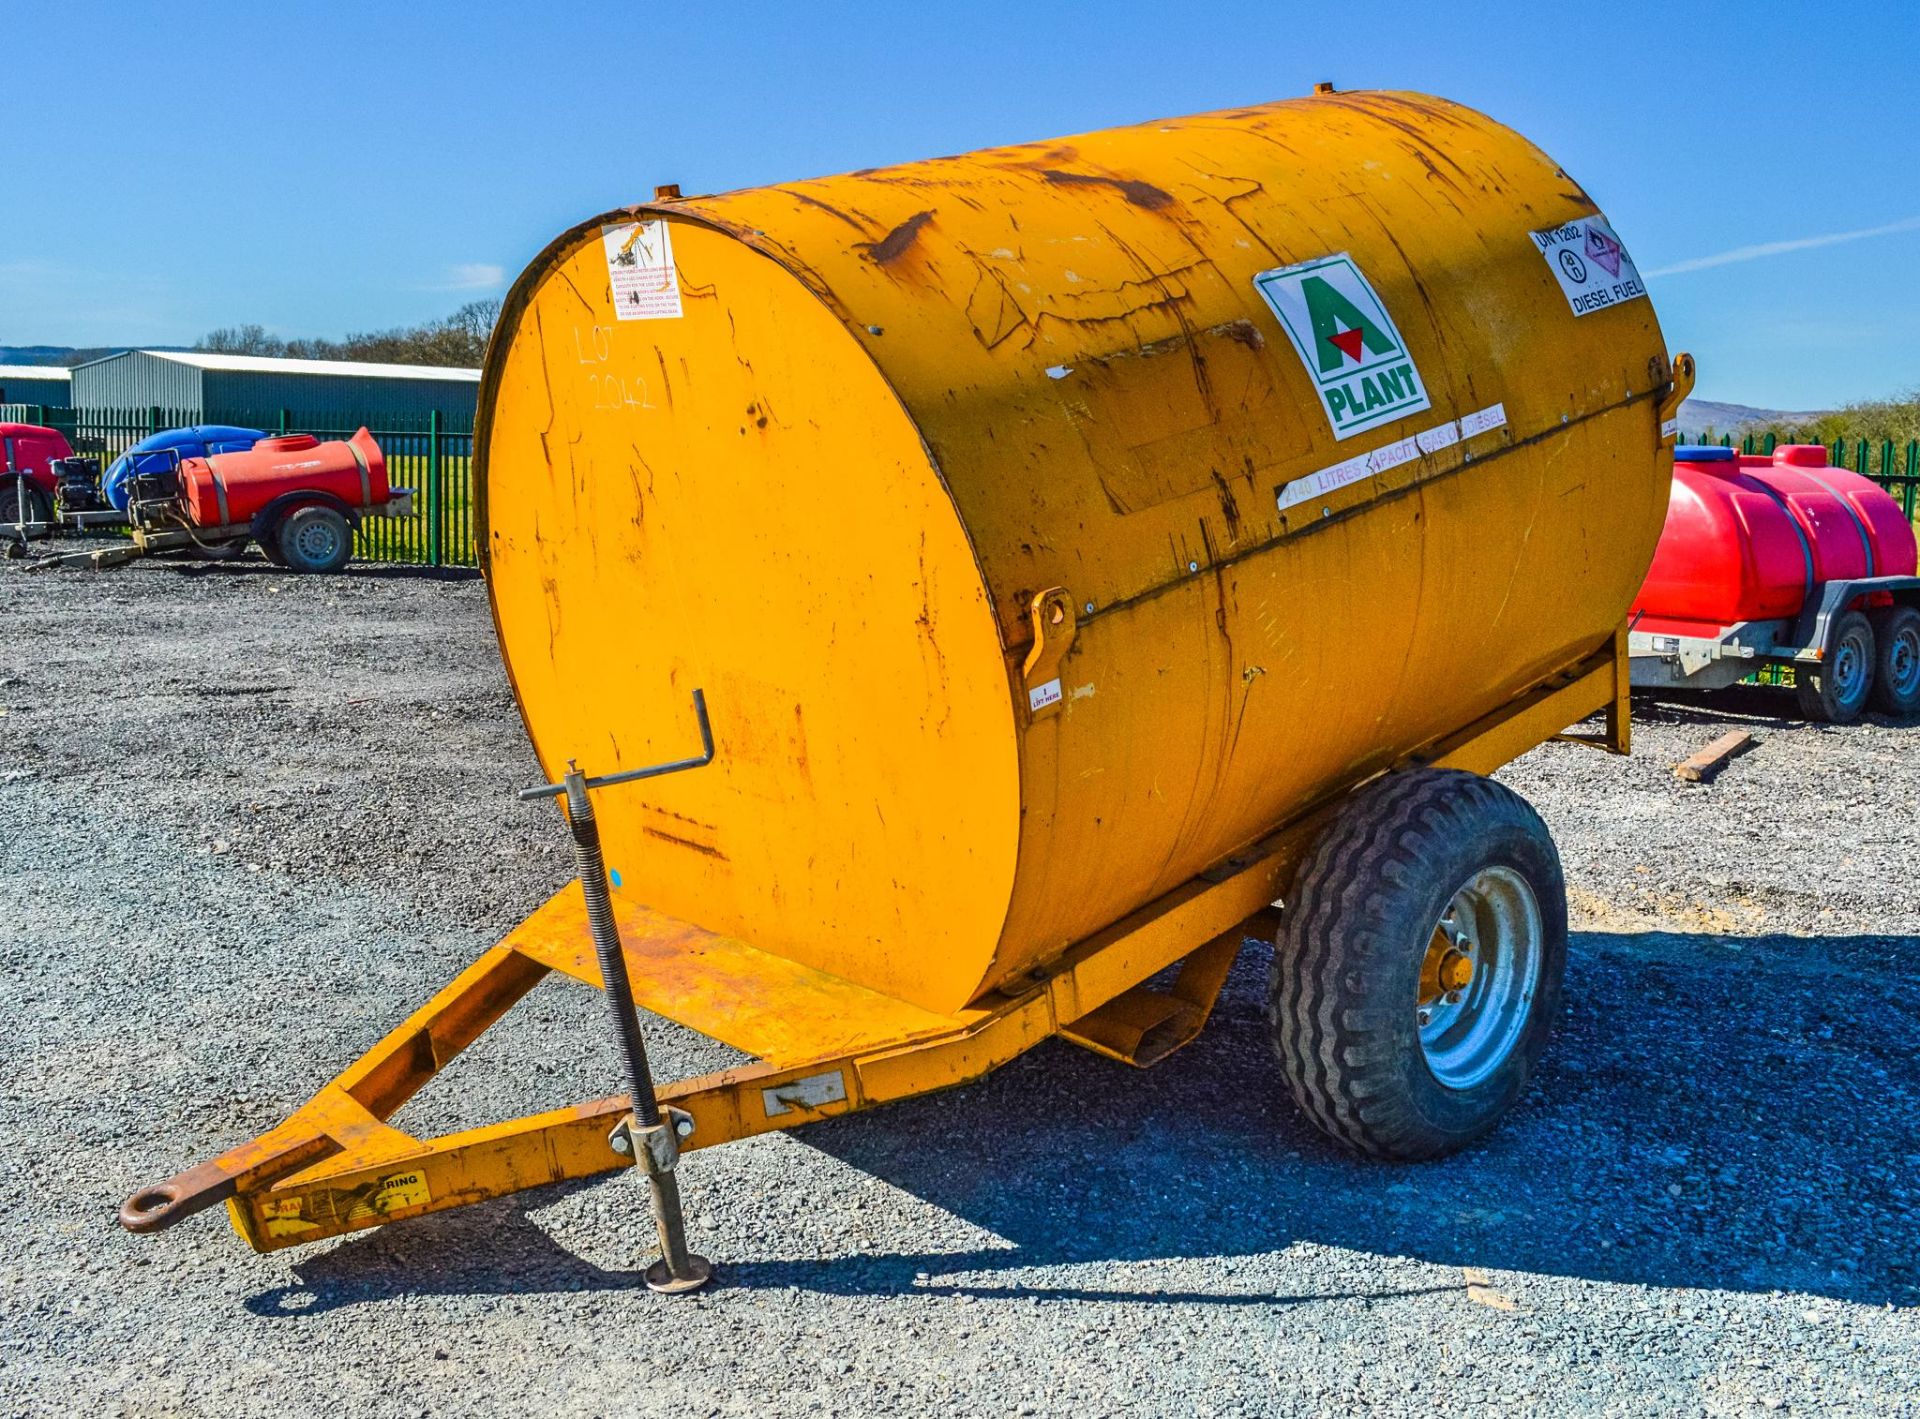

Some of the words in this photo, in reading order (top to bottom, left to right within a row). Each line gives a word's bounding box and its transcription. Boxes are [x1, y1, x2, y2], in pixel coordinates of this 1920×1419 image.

[1535, 232, 1556, 248] UN
[1556, 226, 1582, 243] 1202
[1572, 287, 1614, 313] DIESEL
[1612, 279, 1643, 301] FUEL
[1300, 275, 1397, 373] A
[573, 324, 614, 365] LOT
[589, 373, 657, 411] 2042
[1323, 363, 1419, 423] PLANT
[1317, 462, 1361, 490] LITRES
